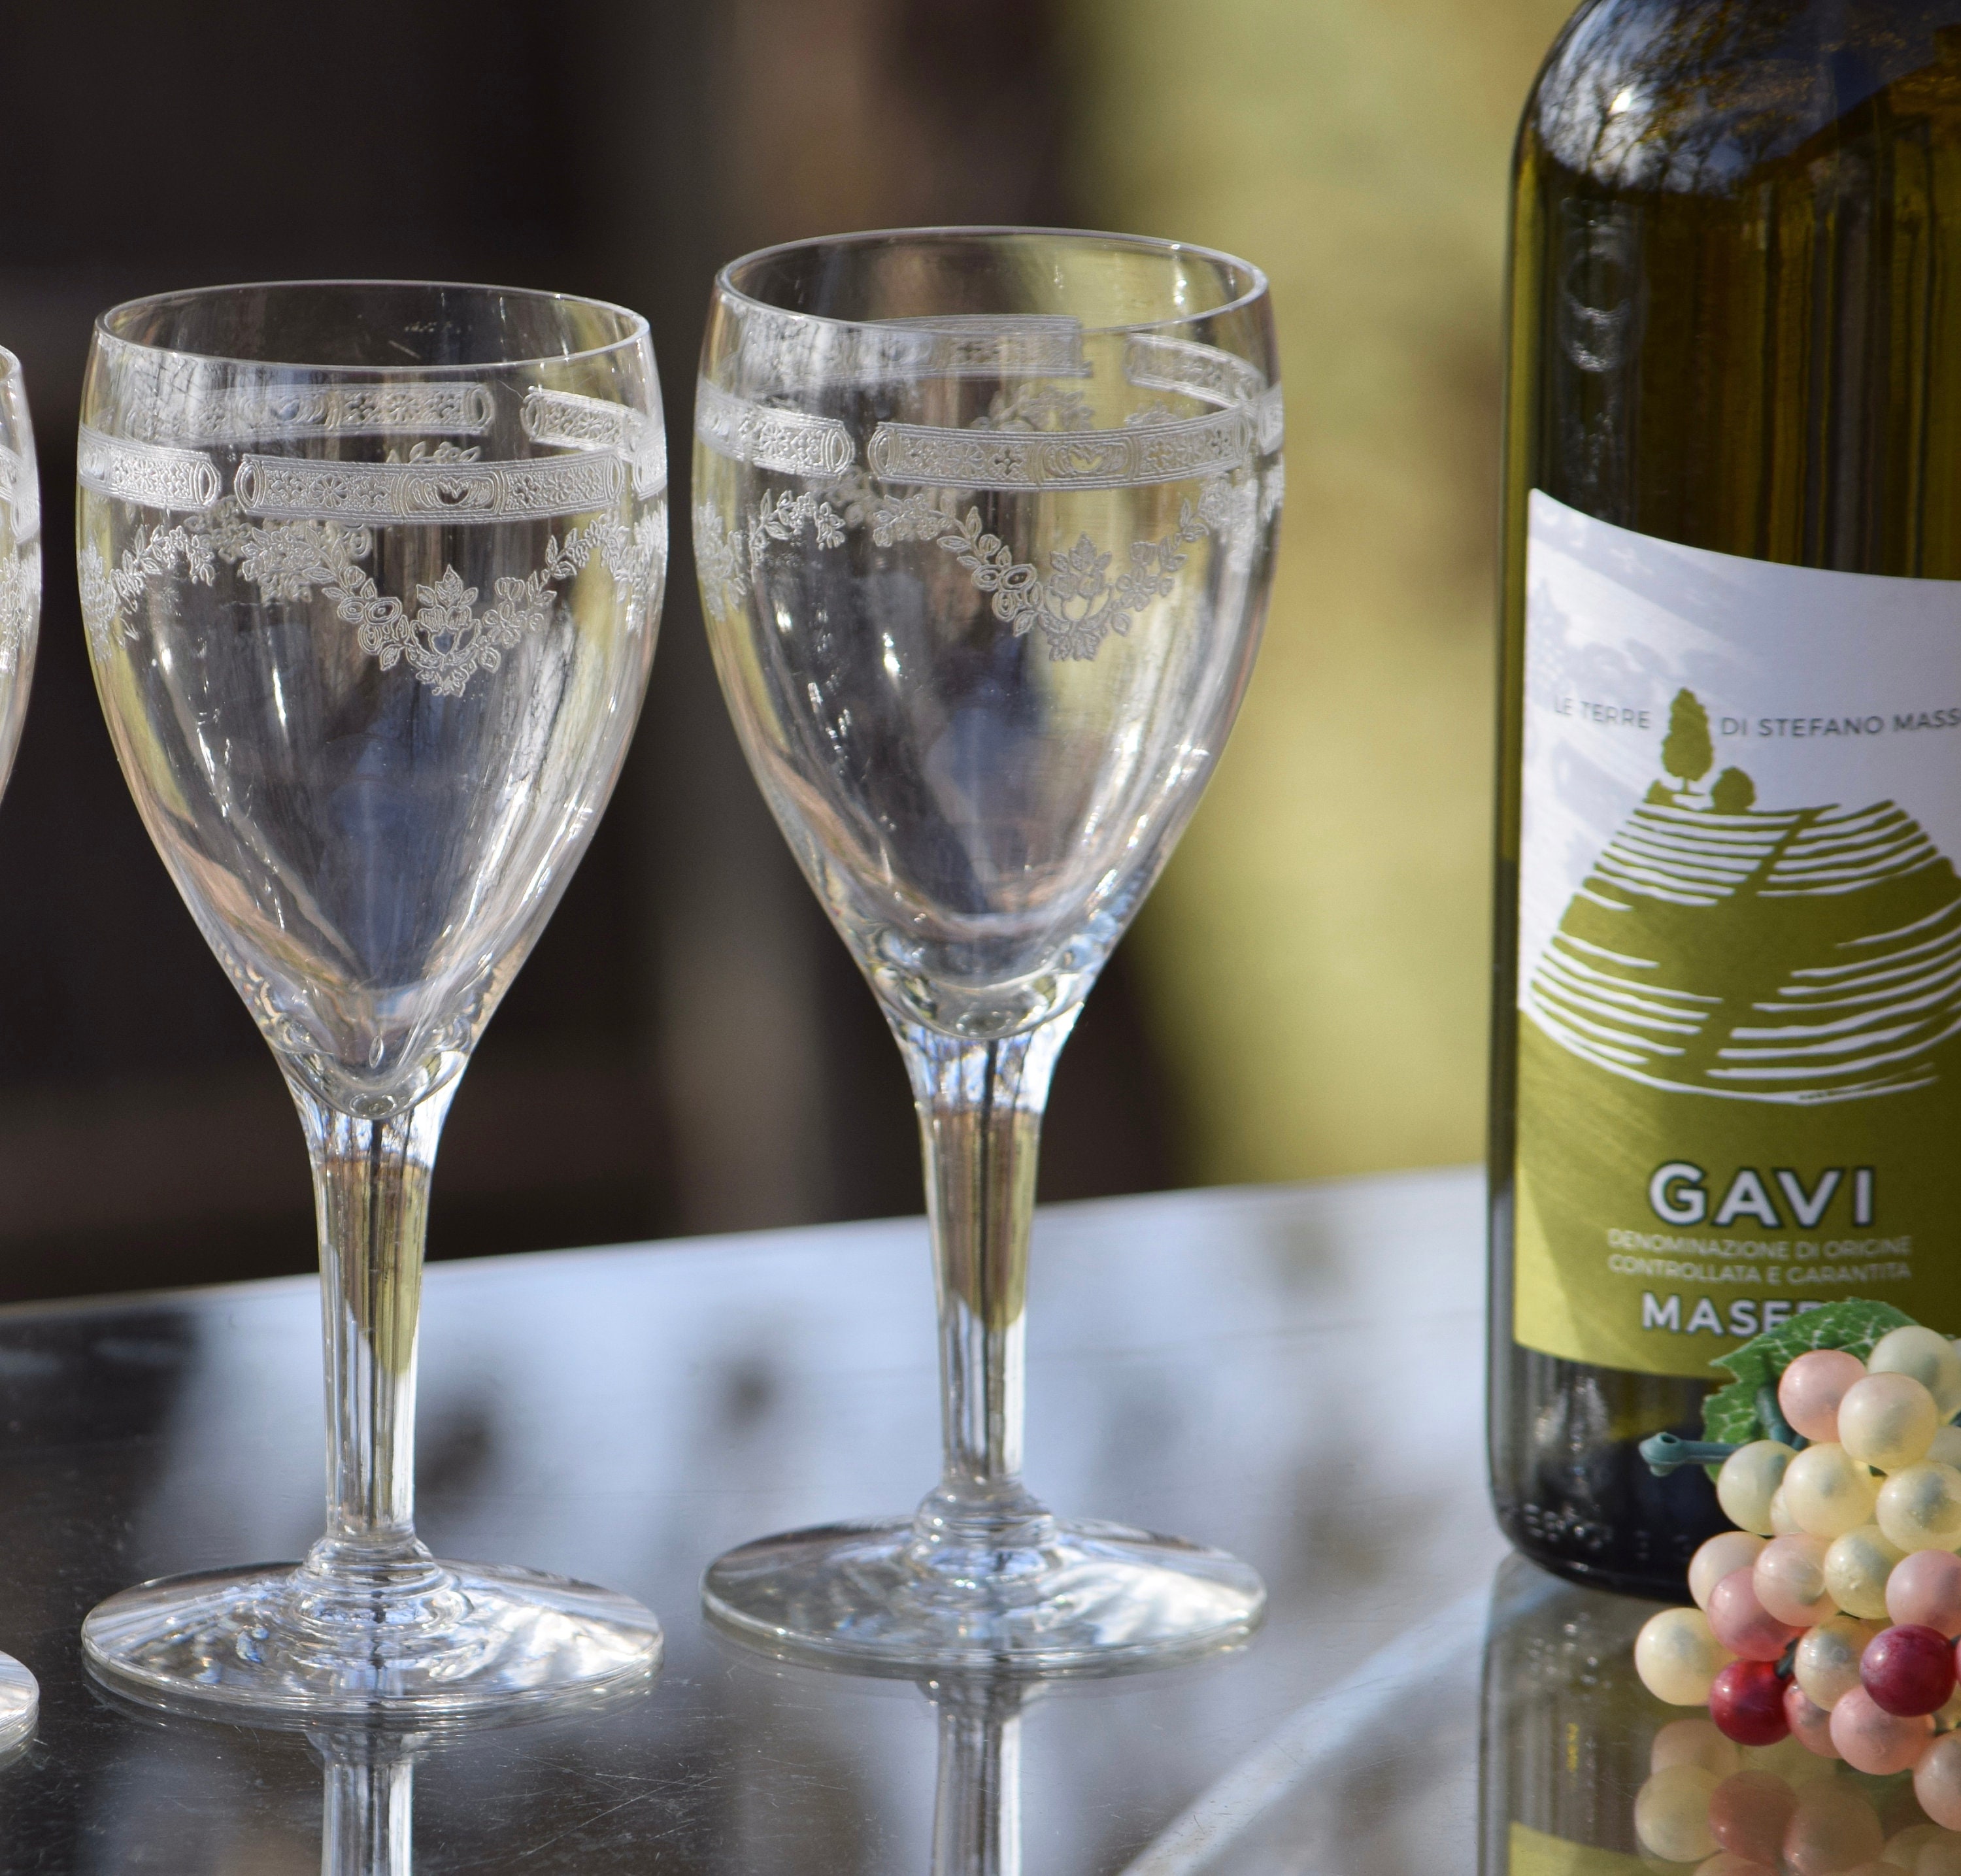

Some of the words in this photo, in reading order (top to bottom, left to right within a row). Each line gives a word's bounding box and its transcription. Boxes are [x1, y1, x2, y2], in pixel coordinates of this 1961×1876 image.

[1554, 694, 1572, 716] LE
[1580, 700, 1651, 729] TERRE
[1721, 717, 1747, 736] DI
[1759, 715, 1884, 737] STEFANO
[1649, 1161, 1875, 1228] GAVI
[1607, 1228, 1790, 1261] DENOMINAZIONE
[1795, 1241, 1820, 1261] DI
[1822, 1235, 1913, 1260] ORIGINE
[1608, 1253, 1762, 1284] CONTROLLATA
[1766, 1265, 1781, 1286] E
